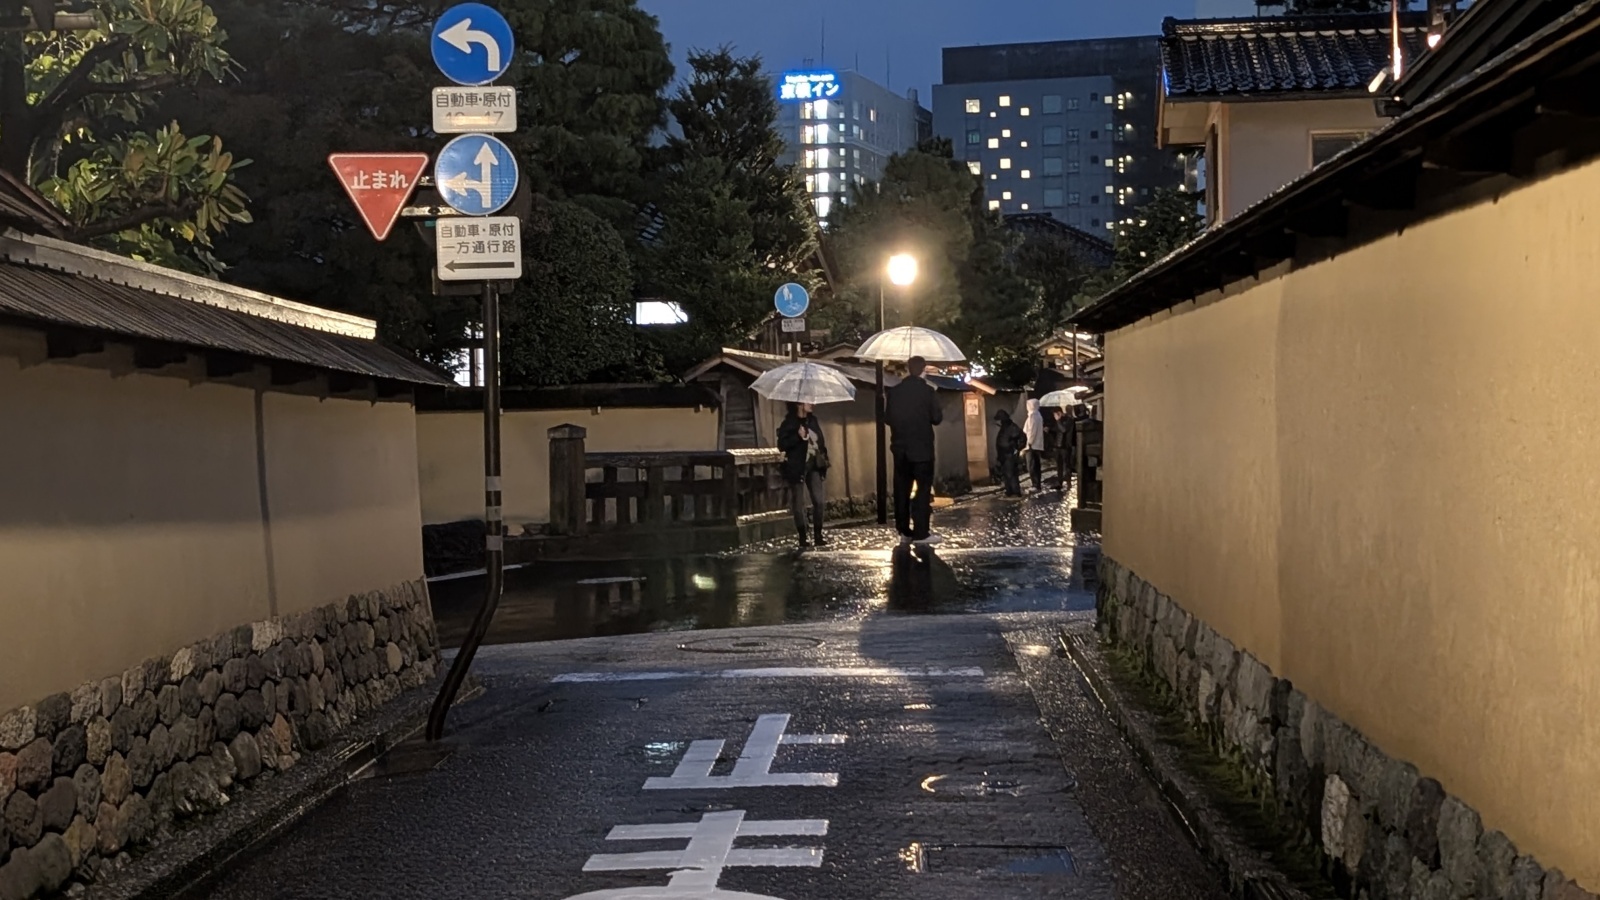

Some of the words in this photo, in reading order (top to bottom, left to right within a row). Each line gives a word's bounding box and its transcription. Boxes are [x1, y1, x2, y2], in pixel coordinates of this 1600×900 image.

[780, 82, 839, 99] イン
[436, 92, 511, 108] 自動車・原付
[351, 170, 409, 190] 止まれ
[441, 223, 515, 238] 自動車・原付
[442, 240, 515, 254] 一方通行路
